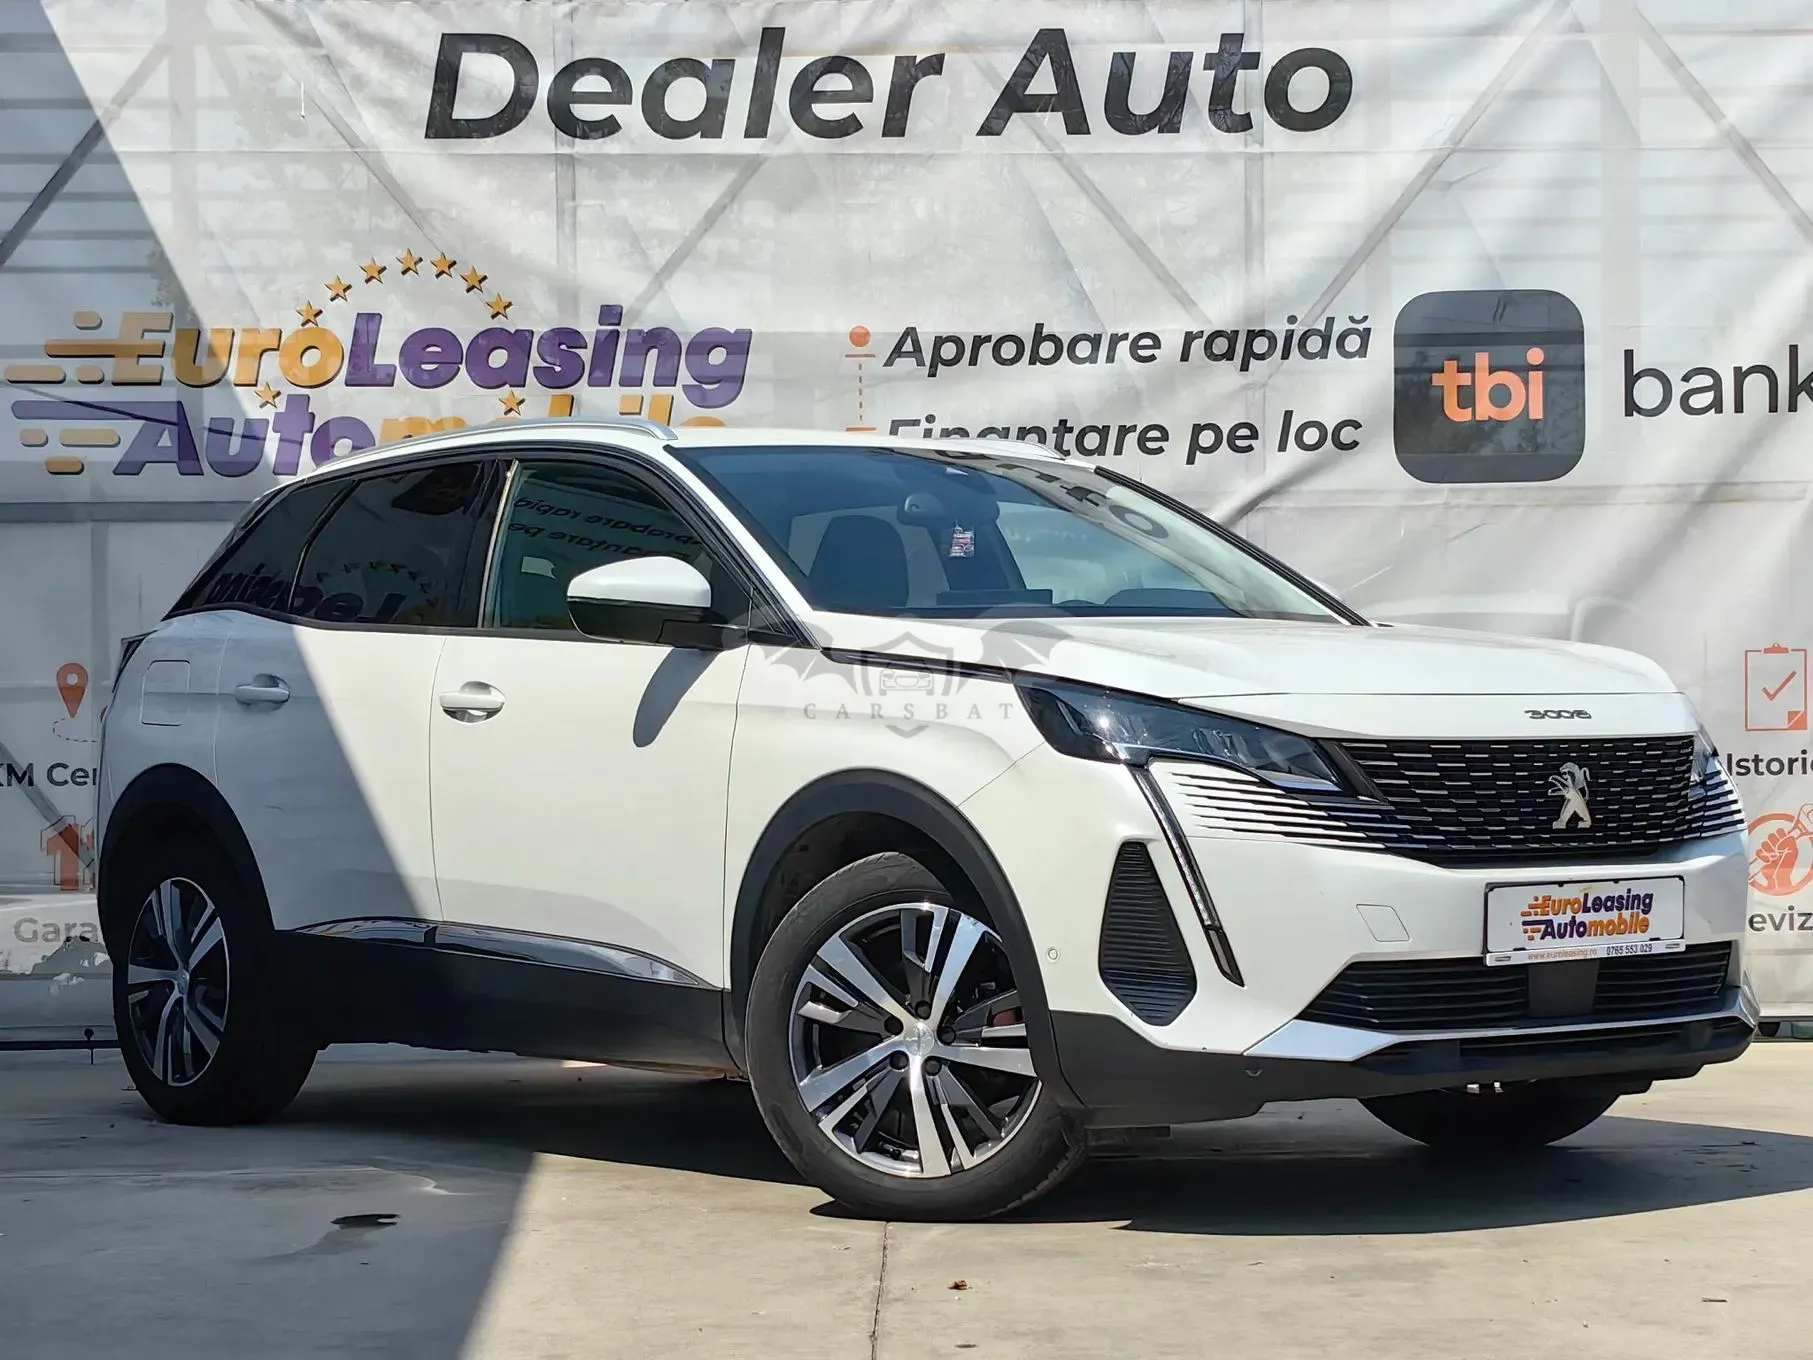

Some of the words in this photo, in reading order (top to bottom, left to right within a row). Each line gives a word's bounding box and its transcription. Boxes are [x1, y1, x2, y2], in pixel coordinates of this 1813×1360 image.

[424, 26, 946, 140] Dealer
[975, 27, 1354, 136] Auto
[110, 304, 753, 410] EuroLeasing
[883, 322, 1162, 378] Aprobare
[1179, 314, 1373, 372] rapidă
[1430, 346, 1546, 422] tbi
[1623, 344, 1813, 418] bank
[1185, 420, 1260, 466] pe
[1276, 410, 1364, 453] loc
[1726, 748, 1813, 777] Istori
[1537, 888, 1654, 917] EuroLeasing
[1538, 912, 1650, 941] Automobile
